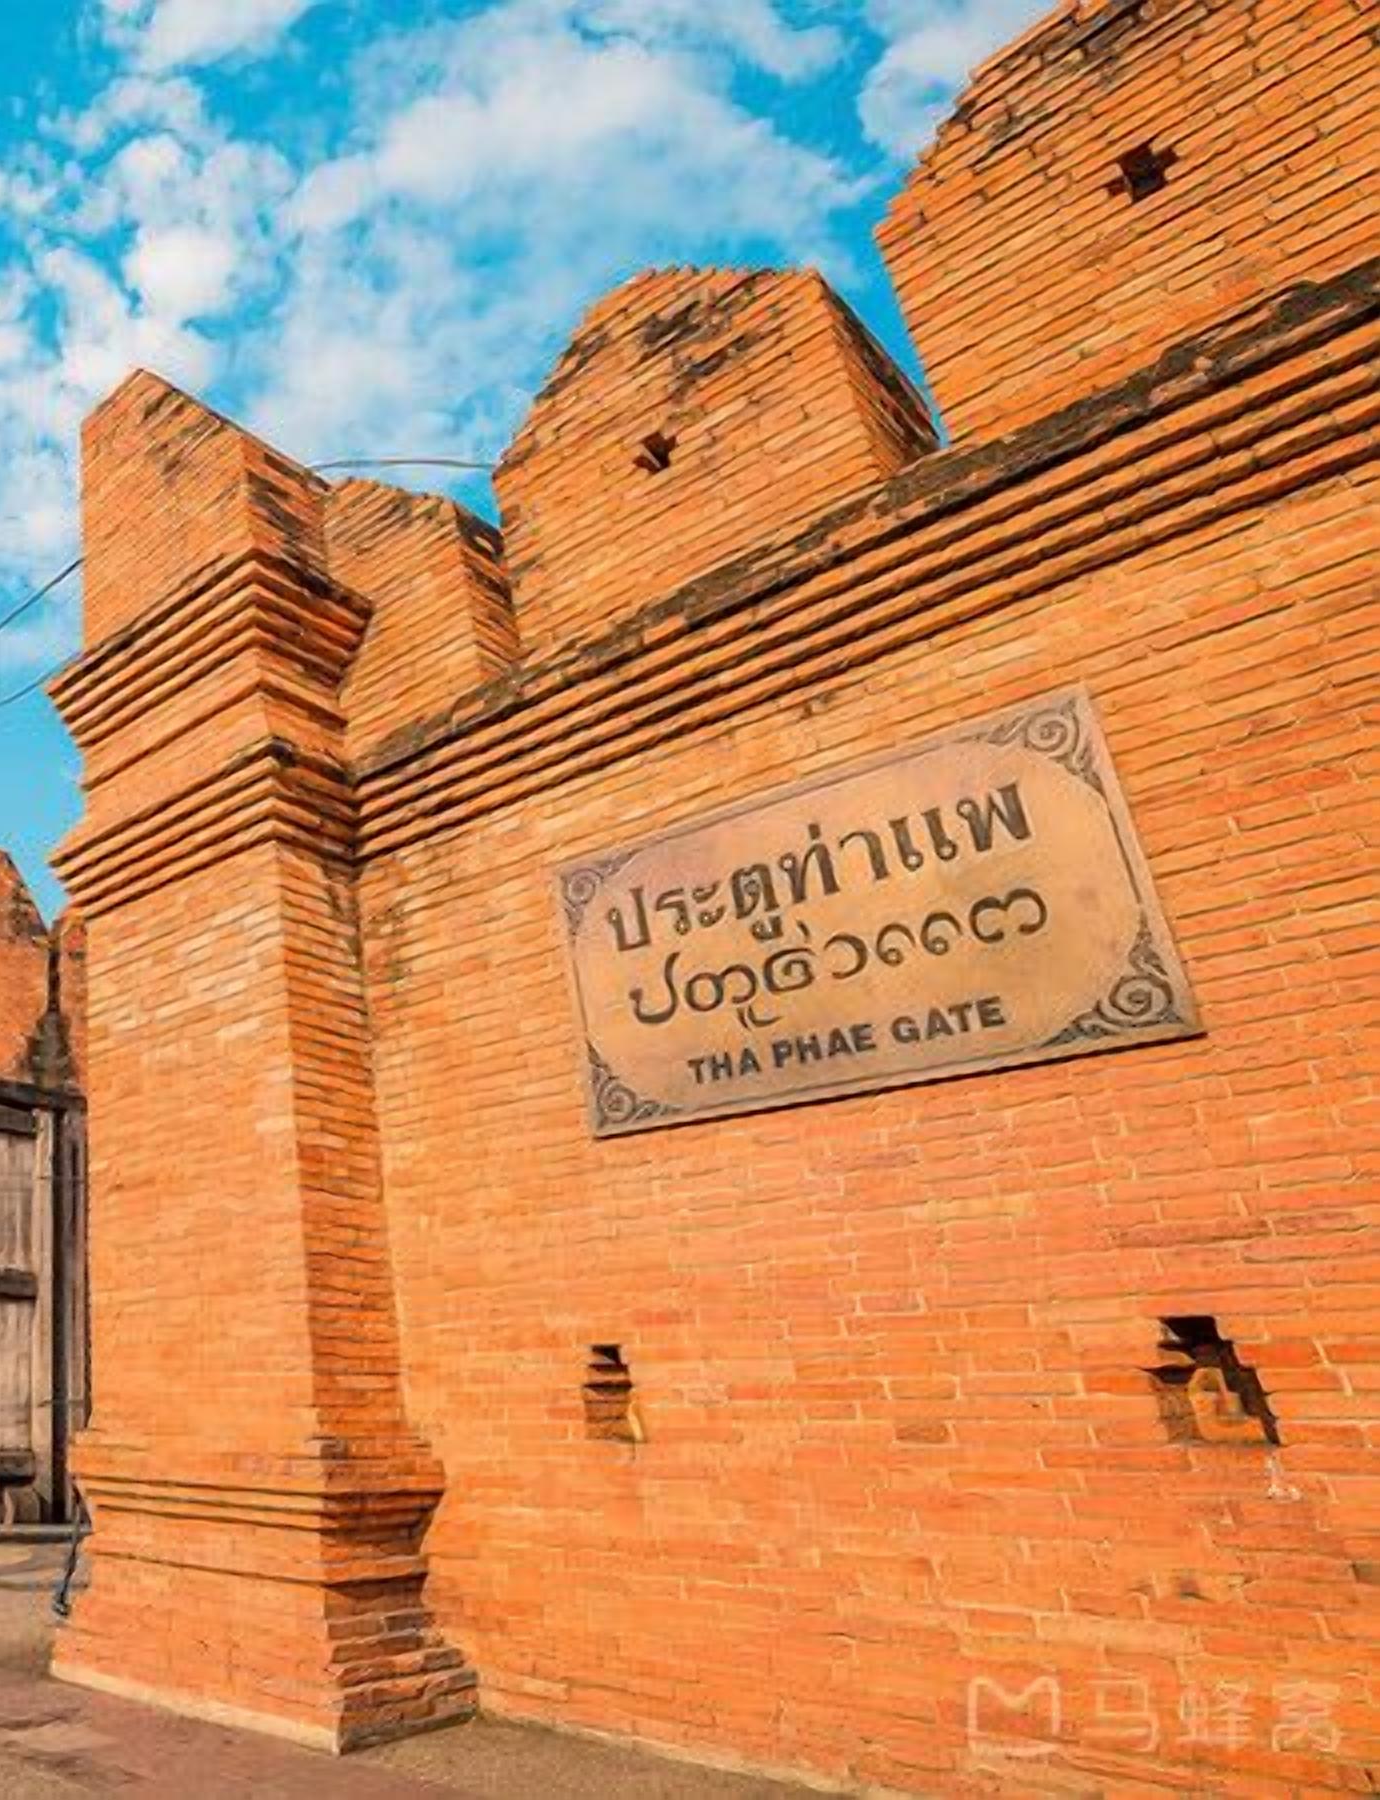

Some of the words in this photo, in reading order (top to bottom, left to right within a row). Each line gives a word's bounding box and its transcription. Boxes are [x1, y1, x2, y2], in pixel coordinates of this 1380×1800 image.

[607, 783, 1033, 952] ประตูท่าแพ
[687, 1049, 762, 1085] THA
[771, 1022, 877, 1068] PHAE
[891, 996, 1006, 1043] GATE
